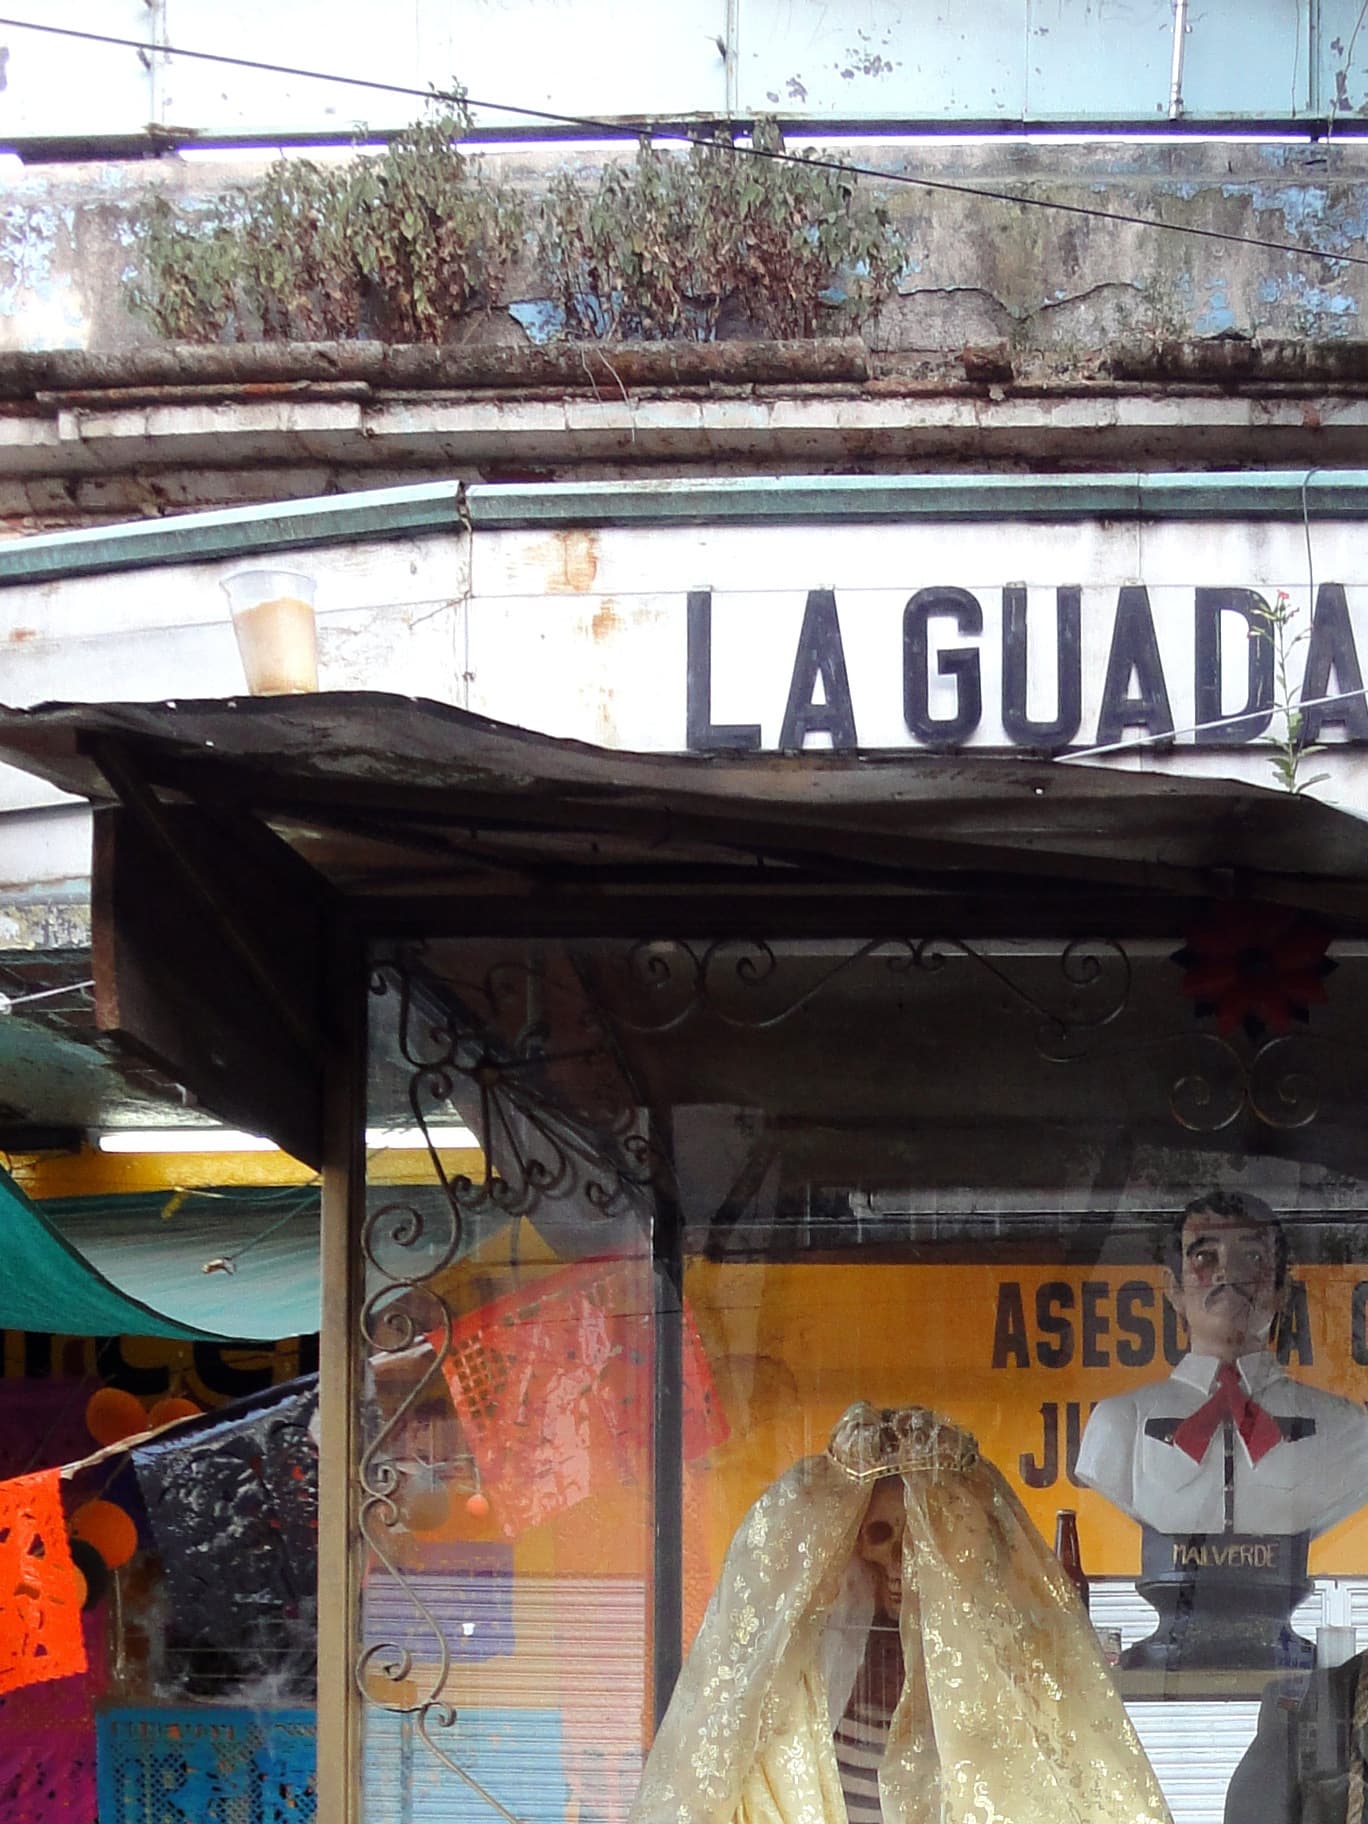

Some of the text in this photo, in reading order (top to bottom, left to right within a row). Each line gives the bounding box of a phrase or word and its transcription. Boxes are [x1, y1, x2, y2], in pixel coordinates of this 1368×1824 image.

[686, 587, 858, 749] LA
[991, 1280, 1314, 1369] ASESOA
[1172, 1543, 1280, 1568] MALVERDE
